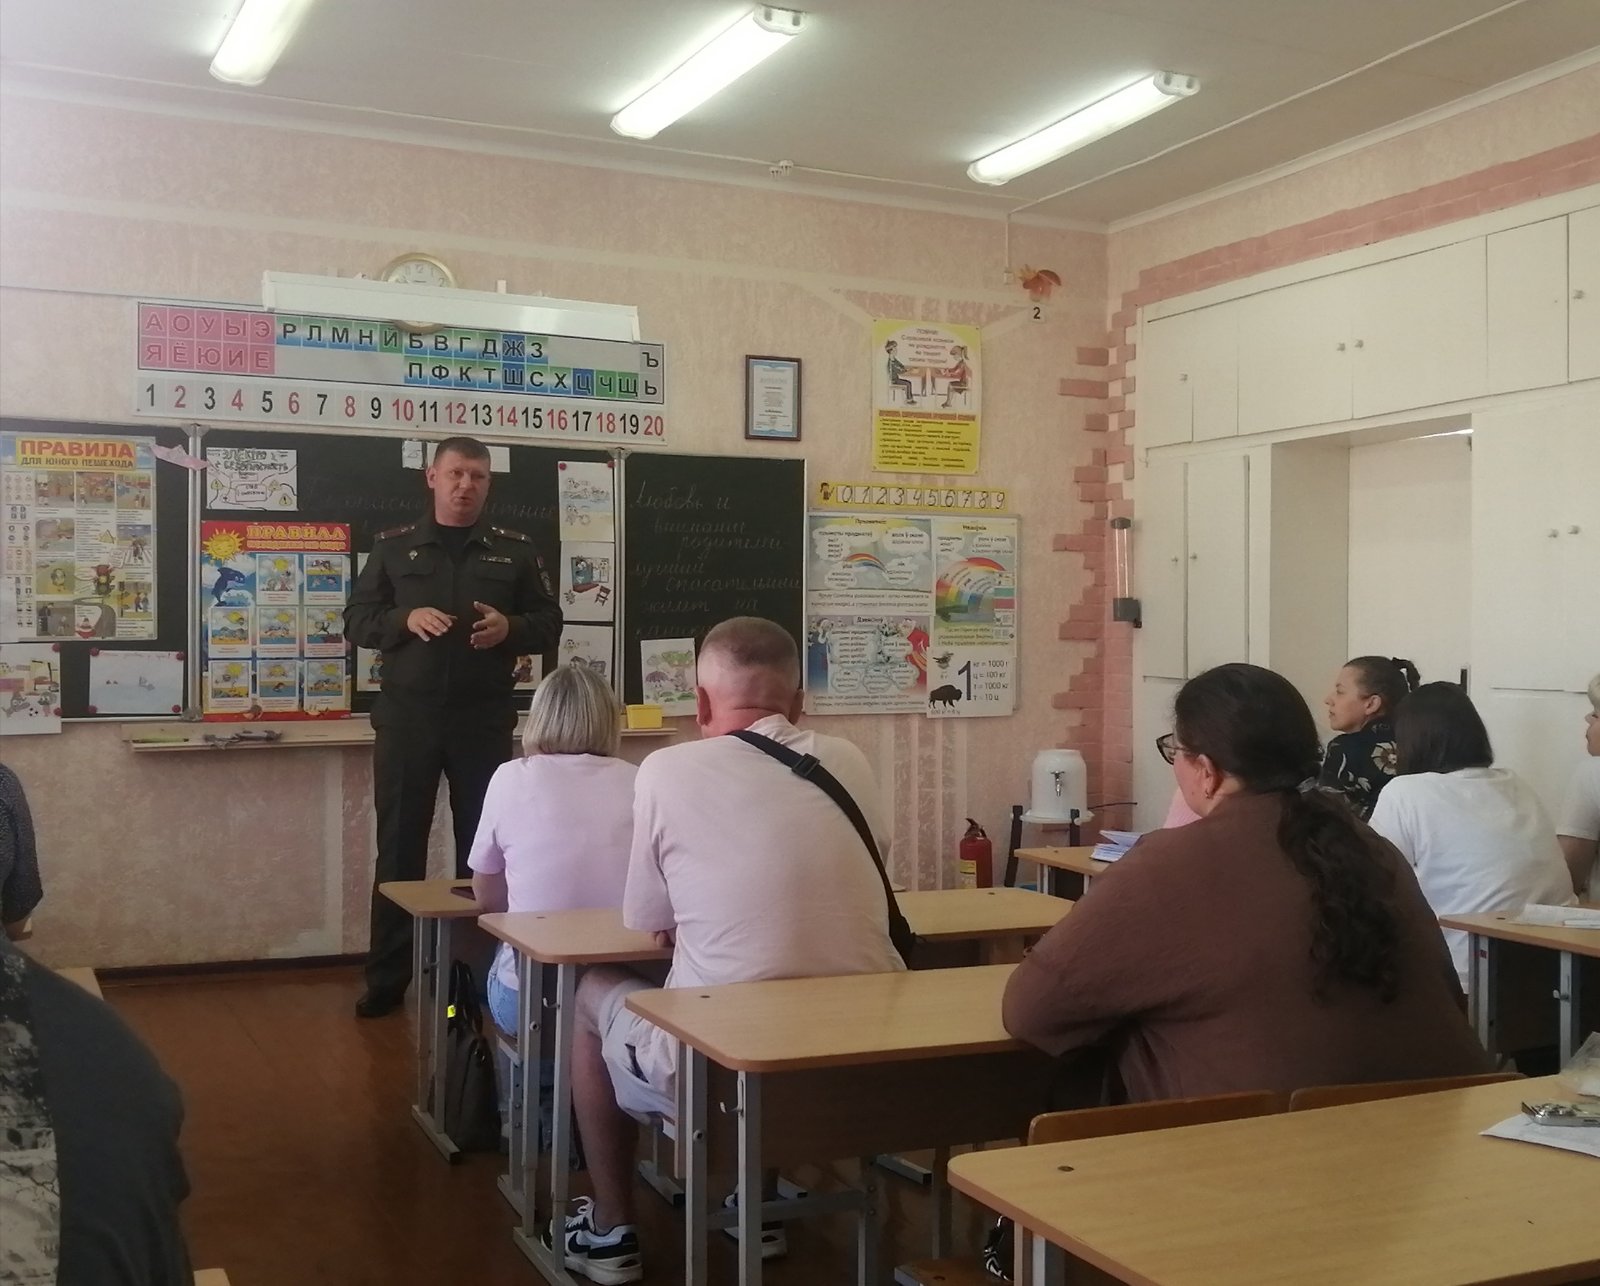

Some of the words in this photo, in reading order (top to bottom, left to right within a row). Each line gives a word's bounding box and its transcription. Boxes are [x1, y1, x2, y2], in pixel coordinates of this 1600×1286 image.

[1033, 306, 1041, 320] 2
[145, 314, 163, 330] А
[173, 315, 190, 332] О
[200, 317, 216, 333] У
[225, 321, 247, 336] Ы
[255, 322, 270, 337] Э
[282, 323, 297, 339] Р
[307, 325, 322, 341] Л
[332, 327, 349, 343] М
[359, 329, 373, 345] Н
[384, 328, 398, 347] Й
[409, 333, 424, 349] Б
[434, 336, 449, 351] В
[460, 337, 471, 352] Г
[481, 339, 498, 357] Д
[503, 341, 524, 356] Ж
[531, 343, 542, 358] З
[642, 352, 659, 367] Ъ
[146, 345, 162, 361] Я
[174, 342, 189, 362] Ё
[199, 348, 220, 365] Ю
[228, 350, 244, 366] И
[255, 351, 269, 369] Е
[409, 363, 423, 379] П
[432, 365, 449, 380] Ф
[459, 367, 472, 382] К
[483, 368, 496, 383] Т
[505, 370, 523, 385] Ш
[530, 372, 544, 387] С
[554, 373, 567, 388] Х
[576, 375, 591, 393] Ц
[600, 377, 612, 392] Ч
[619, 378, 638, 396] Щ
[644, 381, 657, 395] Ь
[146, 384, 155, 407] 1
[175, 385, 186, 408] 2
[205, 387, 216, 409] 3
[231, 389, 243, 411] 4
[262, 391, 273, 412] 5
[289, 392, 300, 414] 6
[317, 394, 328, 415] 7
[345, 395, 355, 417] 8
[371, 397, 381, 419] 9
[392, 399, 414, 421] 10
[419, 400, 438, 422] 11
[445, 402, 466, 424] 12
[471, 404, 492, 426] 13
[497, 405, 518, 427] 14
[522, 407, 543, 429] 15
[547, 409, 567, 430] 16
[573, 410, 592, 432] 17
[597, 412, 616, 433] 18
[620, 413, 639, 435] 19
[644, 415, 664, 436] 20
[20, 440, 135, 459] ПРАВИЛА
[21, 456, 42, 466] ДЛЯ
[45, 458, 79, 467] ЮНОГО
[81, 459, 135, 469] ПЕШЕХОДА
[629, 480, 704, 511] Любовь
[841, 486, 852, 503] 0
[861, 487, 870, 504] 1
[876, 487, 888, 505] 2
[893, 488, 904, 505] 3
[913, 488, 922, 505] 4
[928, 489, 938, 506] 5
[945, 490, 955, 507] 6
[962, 490, 972, 507] 7
[979, 491, 989, 508] 8
[995, 492, 1005, 509] 9
[247, 525, 347, 540] ПРАВИЛА
[989, 660, 1004, 668] 1000
[958, 661, 971, 700] 1
